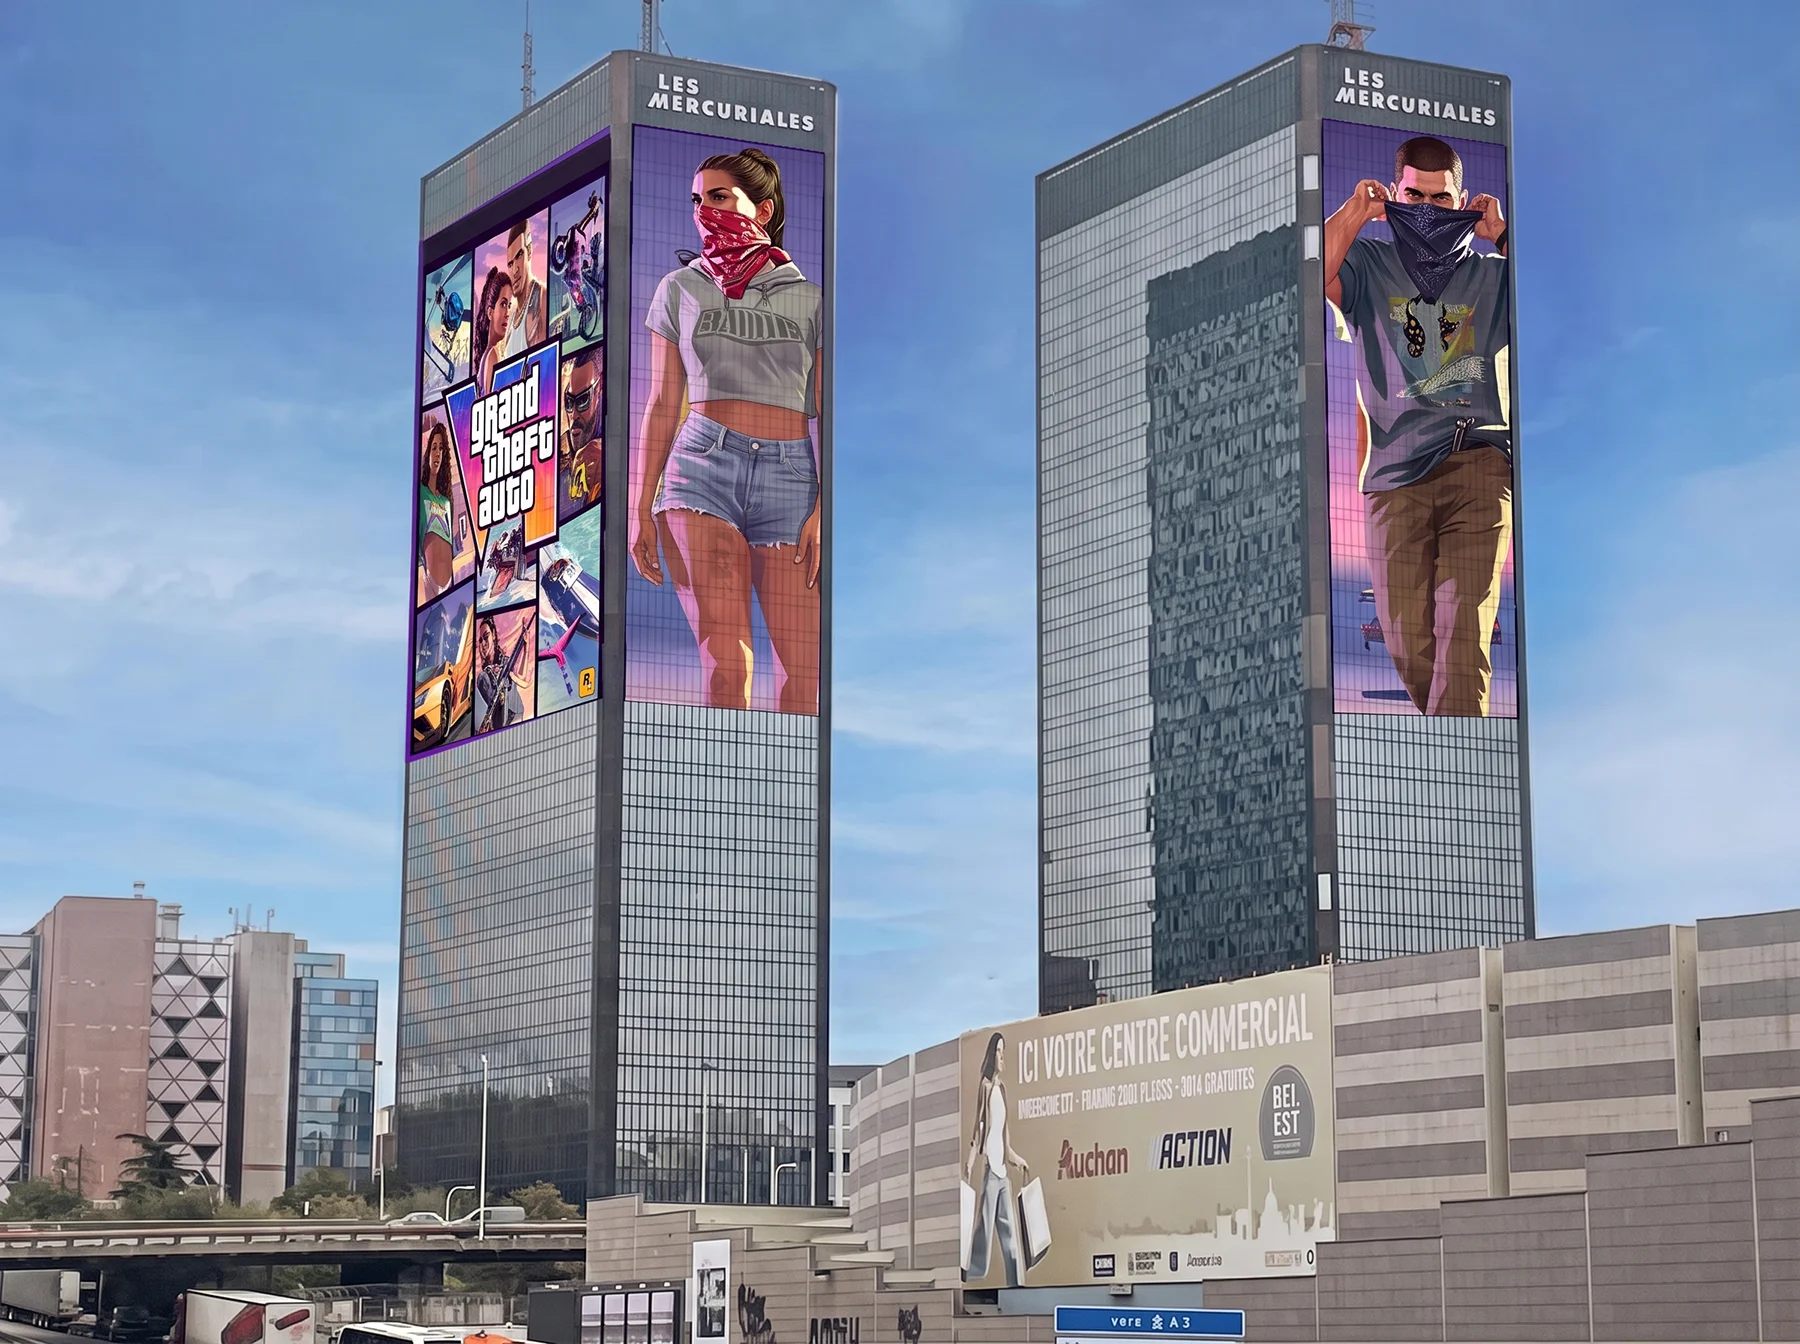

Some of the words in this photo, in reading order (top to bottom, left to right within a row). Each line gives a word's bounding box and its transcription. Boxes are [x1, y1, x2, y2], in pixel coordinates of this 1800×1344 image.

[658, 73, 699, 95] LES
[1344, 67, 1385, 89] LES
[647, 92, 815, 132] MERCURIALES
[1334, 86, 1496, 127] MERCURIALES
[478, 468, 535, 528] auto
[1018, 1038, 1039, 1085] ICI
[1042, 1028, 1097, 1080] VOTRE
[1101, 1015, 1171, 1071] CENTRE
[1175, 992, 1314, 1060] COMMERCIAL
[1204, 1066, 1255, 1095] GRATUITES
[1273, 1109, 1301, 1137] EST
[1057, 1139, 1129, 1180] Auchan
[1159, 1127, 1232, 1170] ACTION
